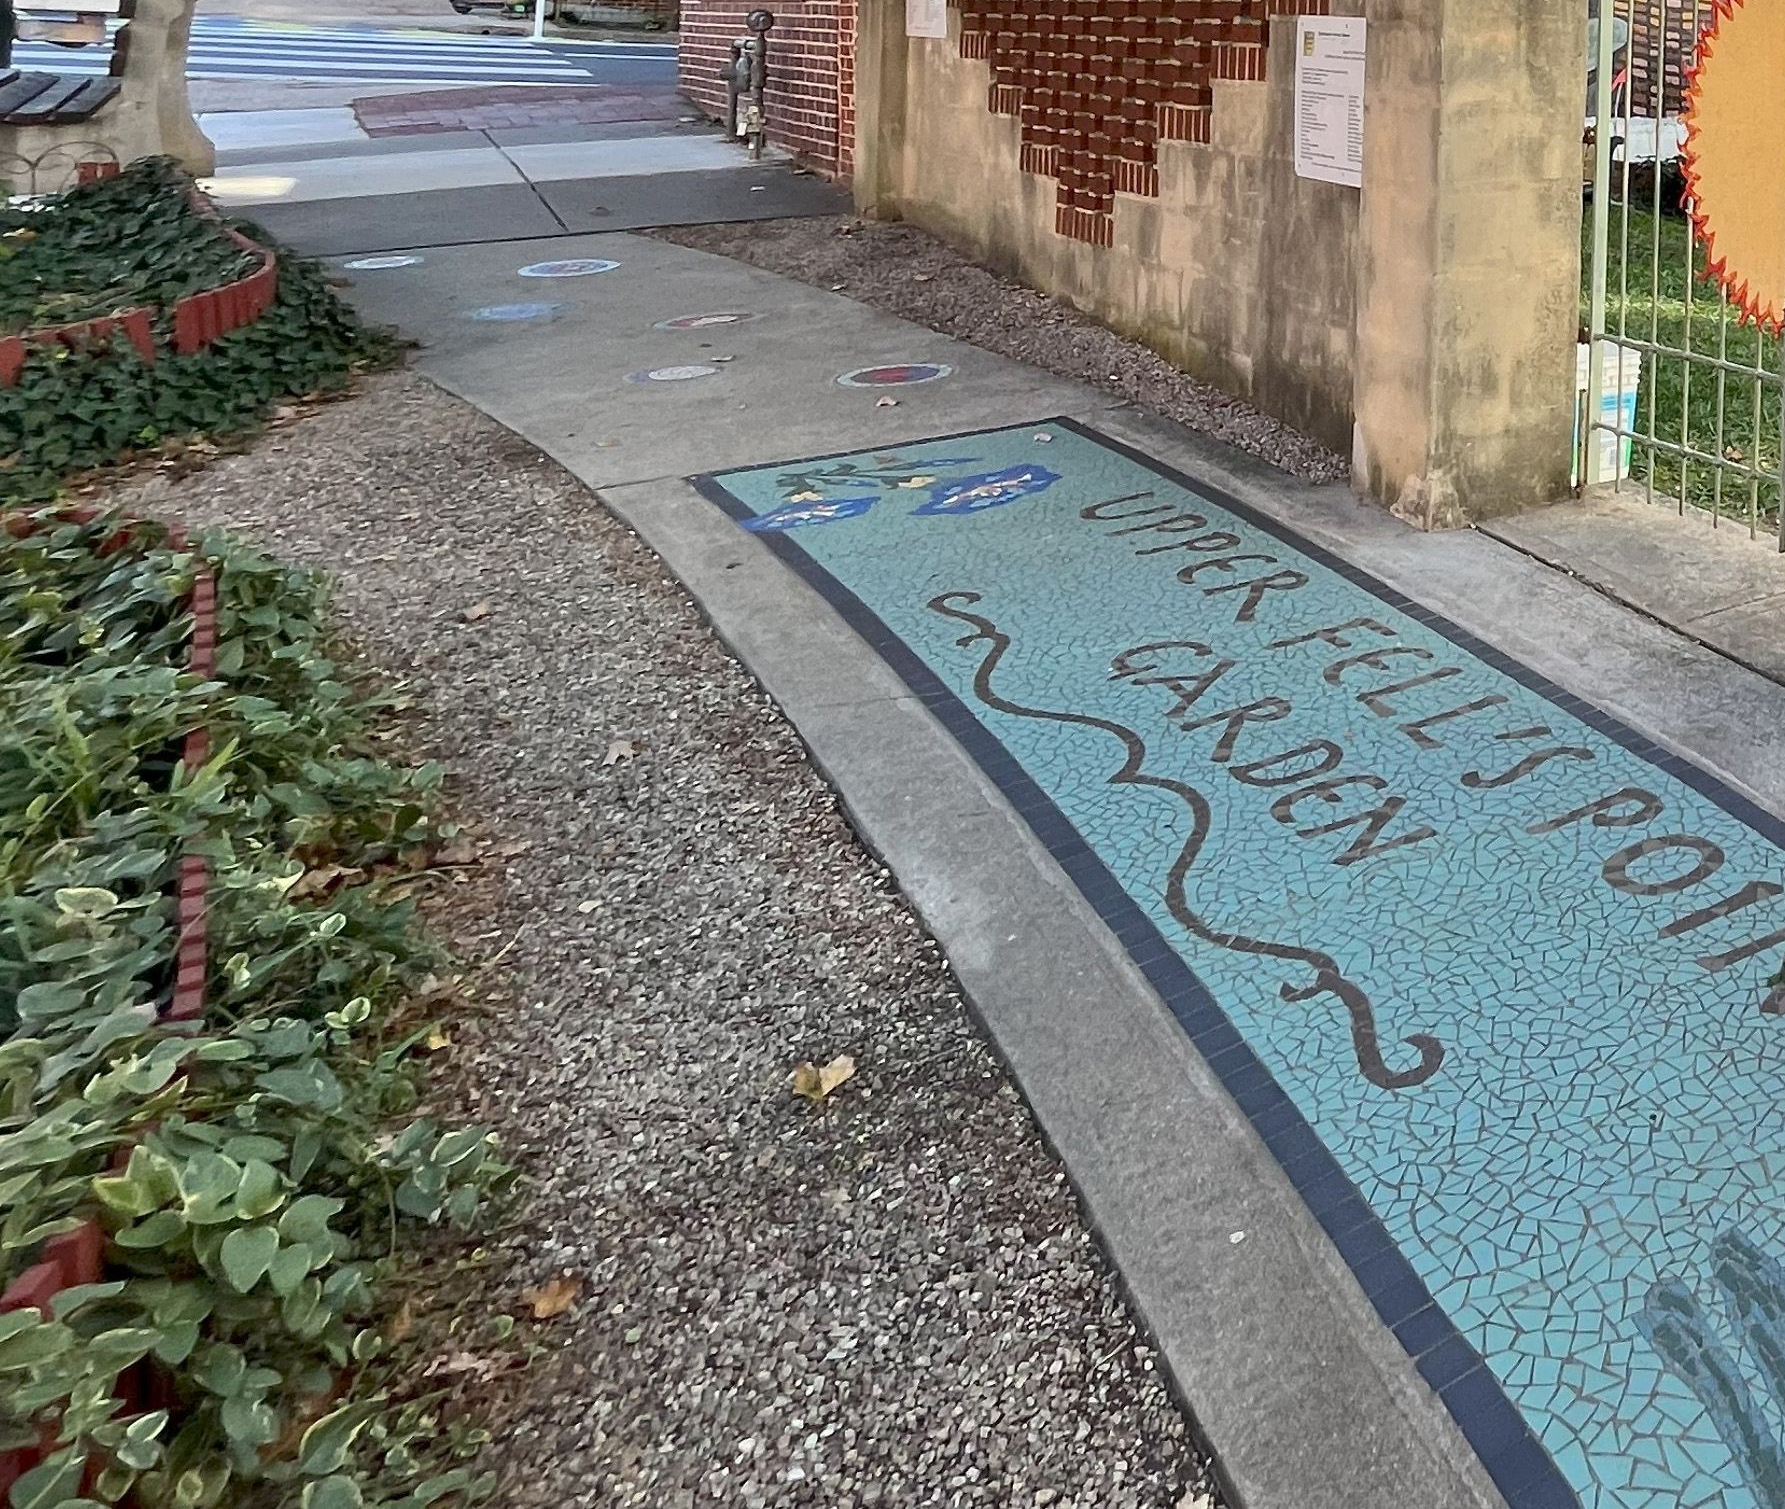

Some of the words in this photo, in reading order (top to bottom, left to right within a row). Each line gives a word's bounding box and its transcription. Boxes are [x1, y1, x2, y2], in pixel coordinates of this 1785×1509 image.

[1081, 490, 1310, 622] UPPER
[1273, 616, 1596, 789] FELL'S
[1108, 639, 1441, 866] GARDEN
